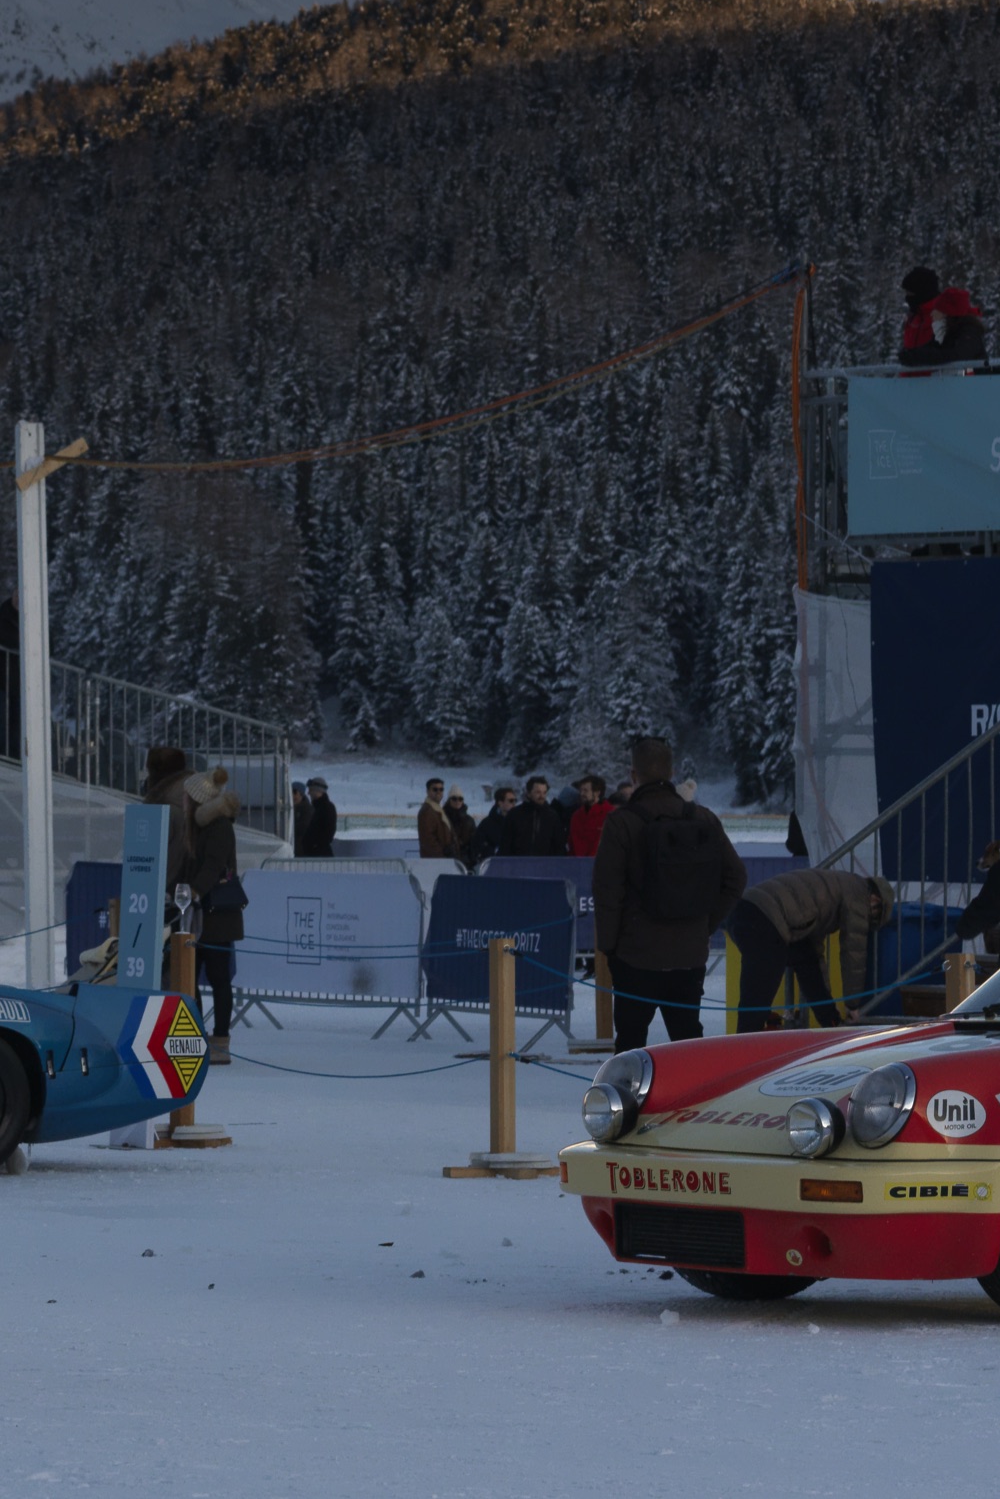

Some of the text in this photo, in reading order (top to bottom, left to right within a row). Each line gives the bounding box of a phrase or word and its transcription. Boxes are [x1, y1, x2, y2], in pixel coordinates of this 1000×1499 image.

[128, 893, 149, 914] 20
[294, 912, 315, 929] THE
[296, 934, 315, 950] ICE
[126, 956, 145, 978] 39
[169, 1038, 202, 1055] RENAULT
[773, 1069, 870, 1086] Unil
[933, 1095, 976, 1122] Unil
[606, 1162, 732, 1195] TOBLERONE
